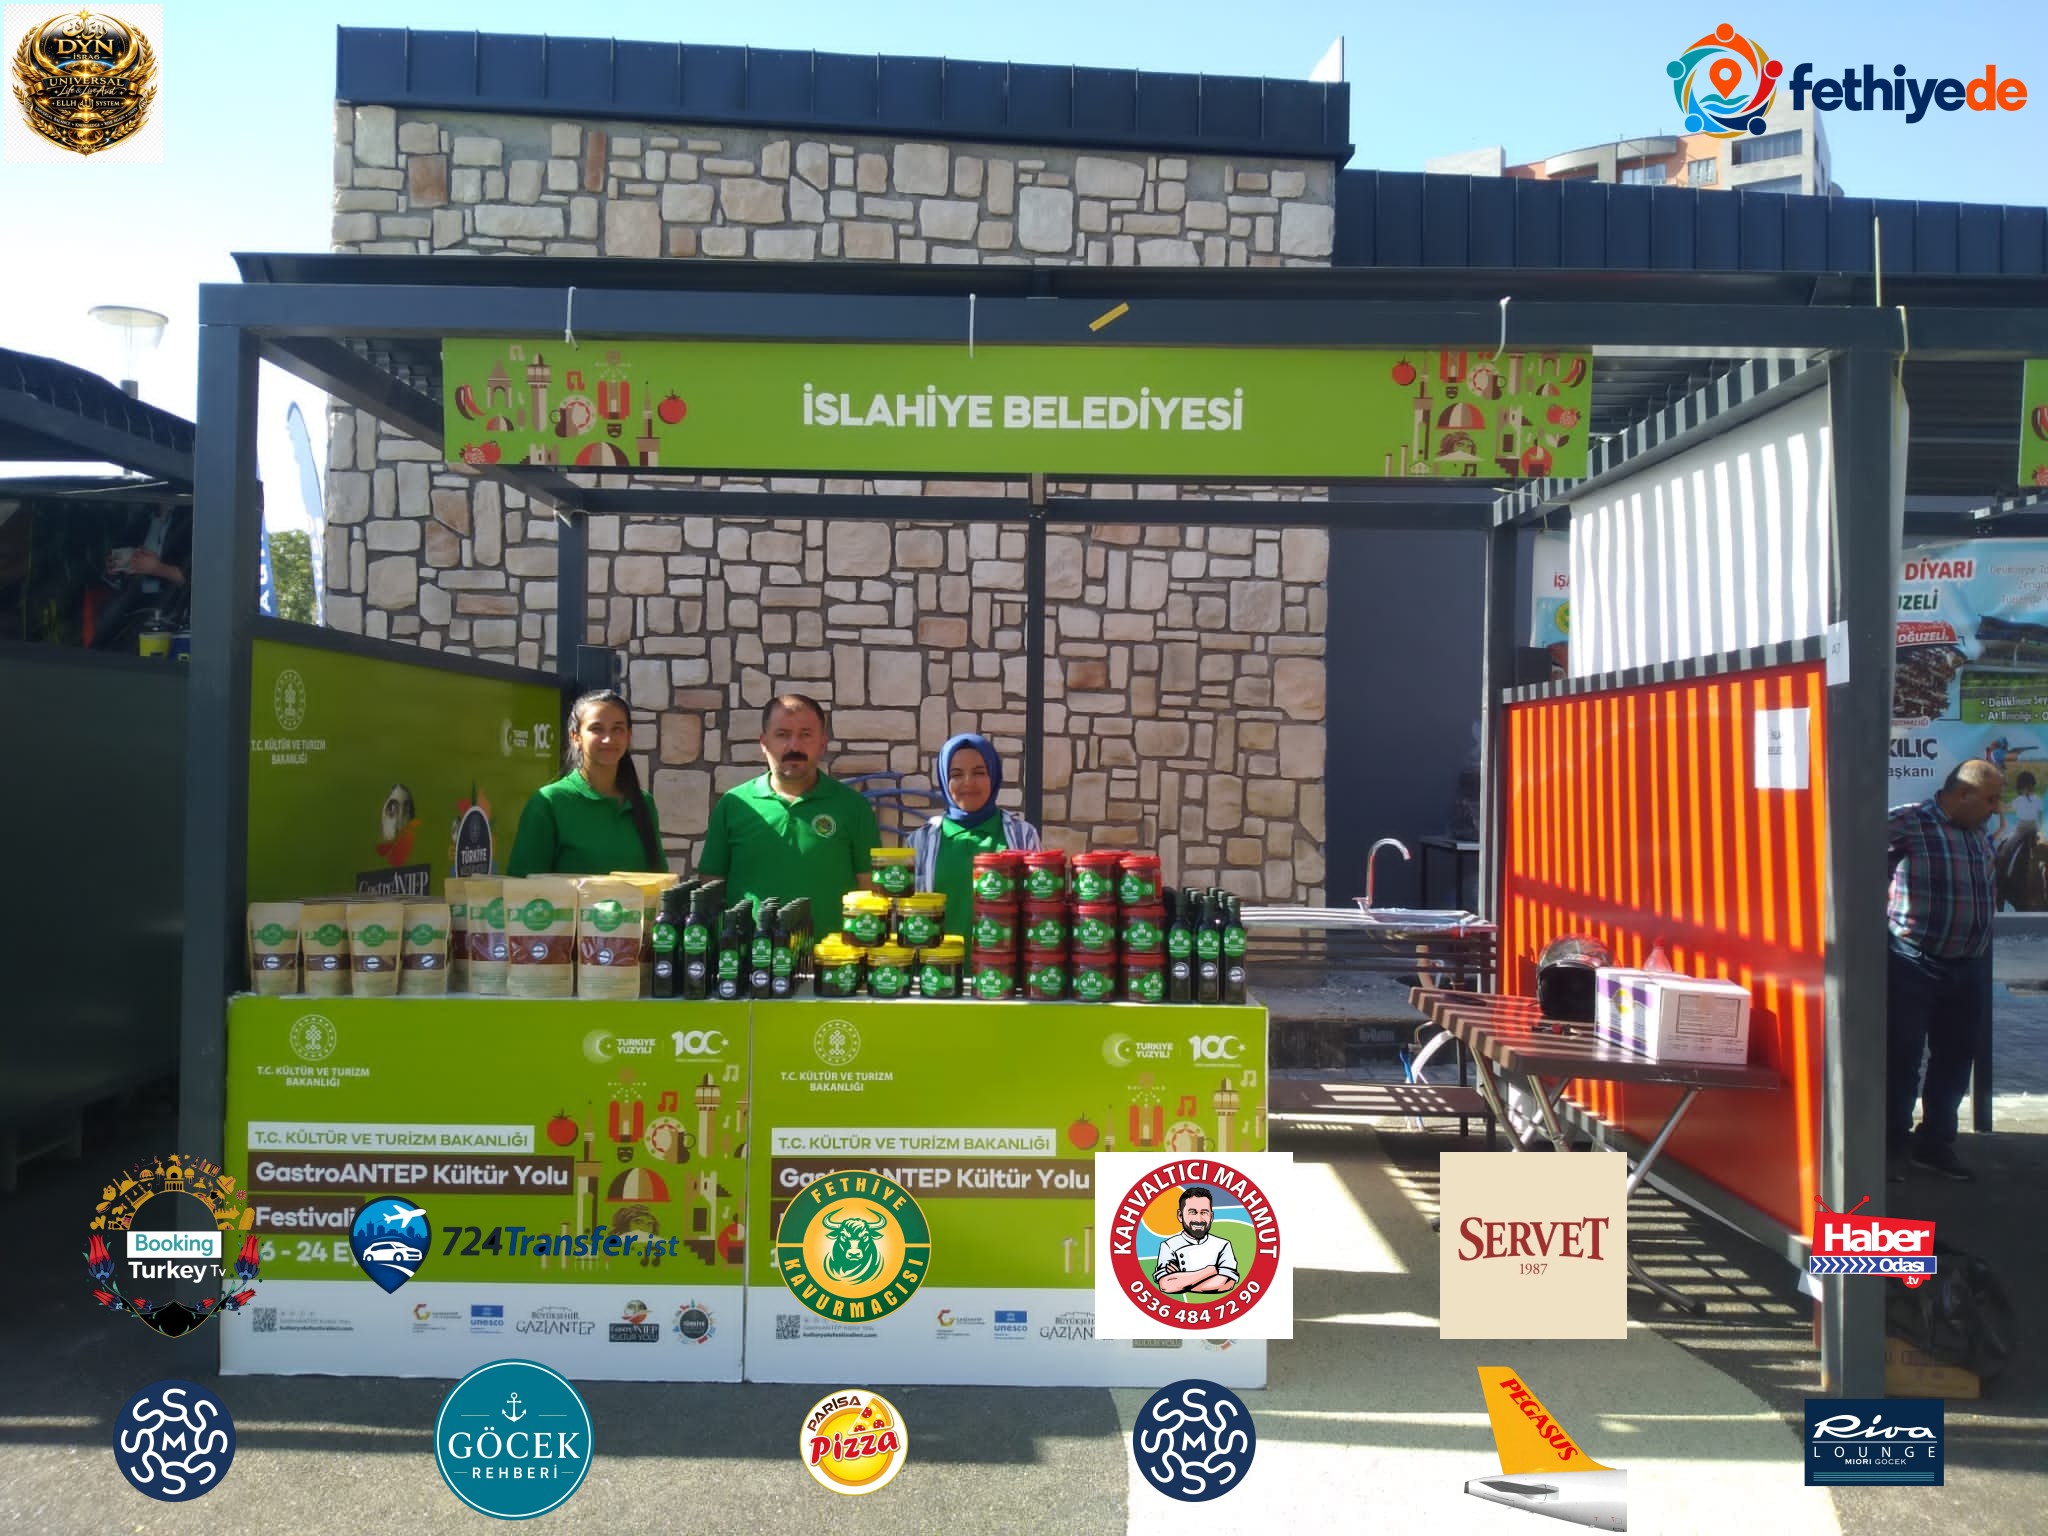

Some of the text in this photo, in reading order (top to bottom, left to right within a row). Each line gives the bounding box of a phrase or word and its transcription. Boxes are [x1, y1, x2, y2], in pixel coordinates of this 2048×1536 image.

[803, 383, 1243, 431] İSLAHİYE BELEDİYESİ
[1905, 557, 1974, 581] DİYARI
[257, 1066, 274, 1076] T.C.
[276, 1065, 314, 1077] KÜLTÜR
[316, 1067, 329, 1077] VE
[781, 1071, 894, 1082] T.C. KÜLTÜR VE TURİZM
[286, 1076, 341, 1088] BAKANLIĞI
[809, 1081, 865, 1092] BAKANLIĞI
[255, 1129, 528, 1147] T.C. KÜLTÜR VE TURİZM BAKANLIĞI
[779, 1134, 1049, 1151] T.C. KÜLTÜR VE TURİZM BAKANLIĞI
[256, 1162, 568, 1186] GastroANTEP Kültür Yolu
[957, 1167, 1032, 1189] Kültür
[1036, 1168, 1089, 1190] Yolu
[296, 1242, 327, 1262] 24
